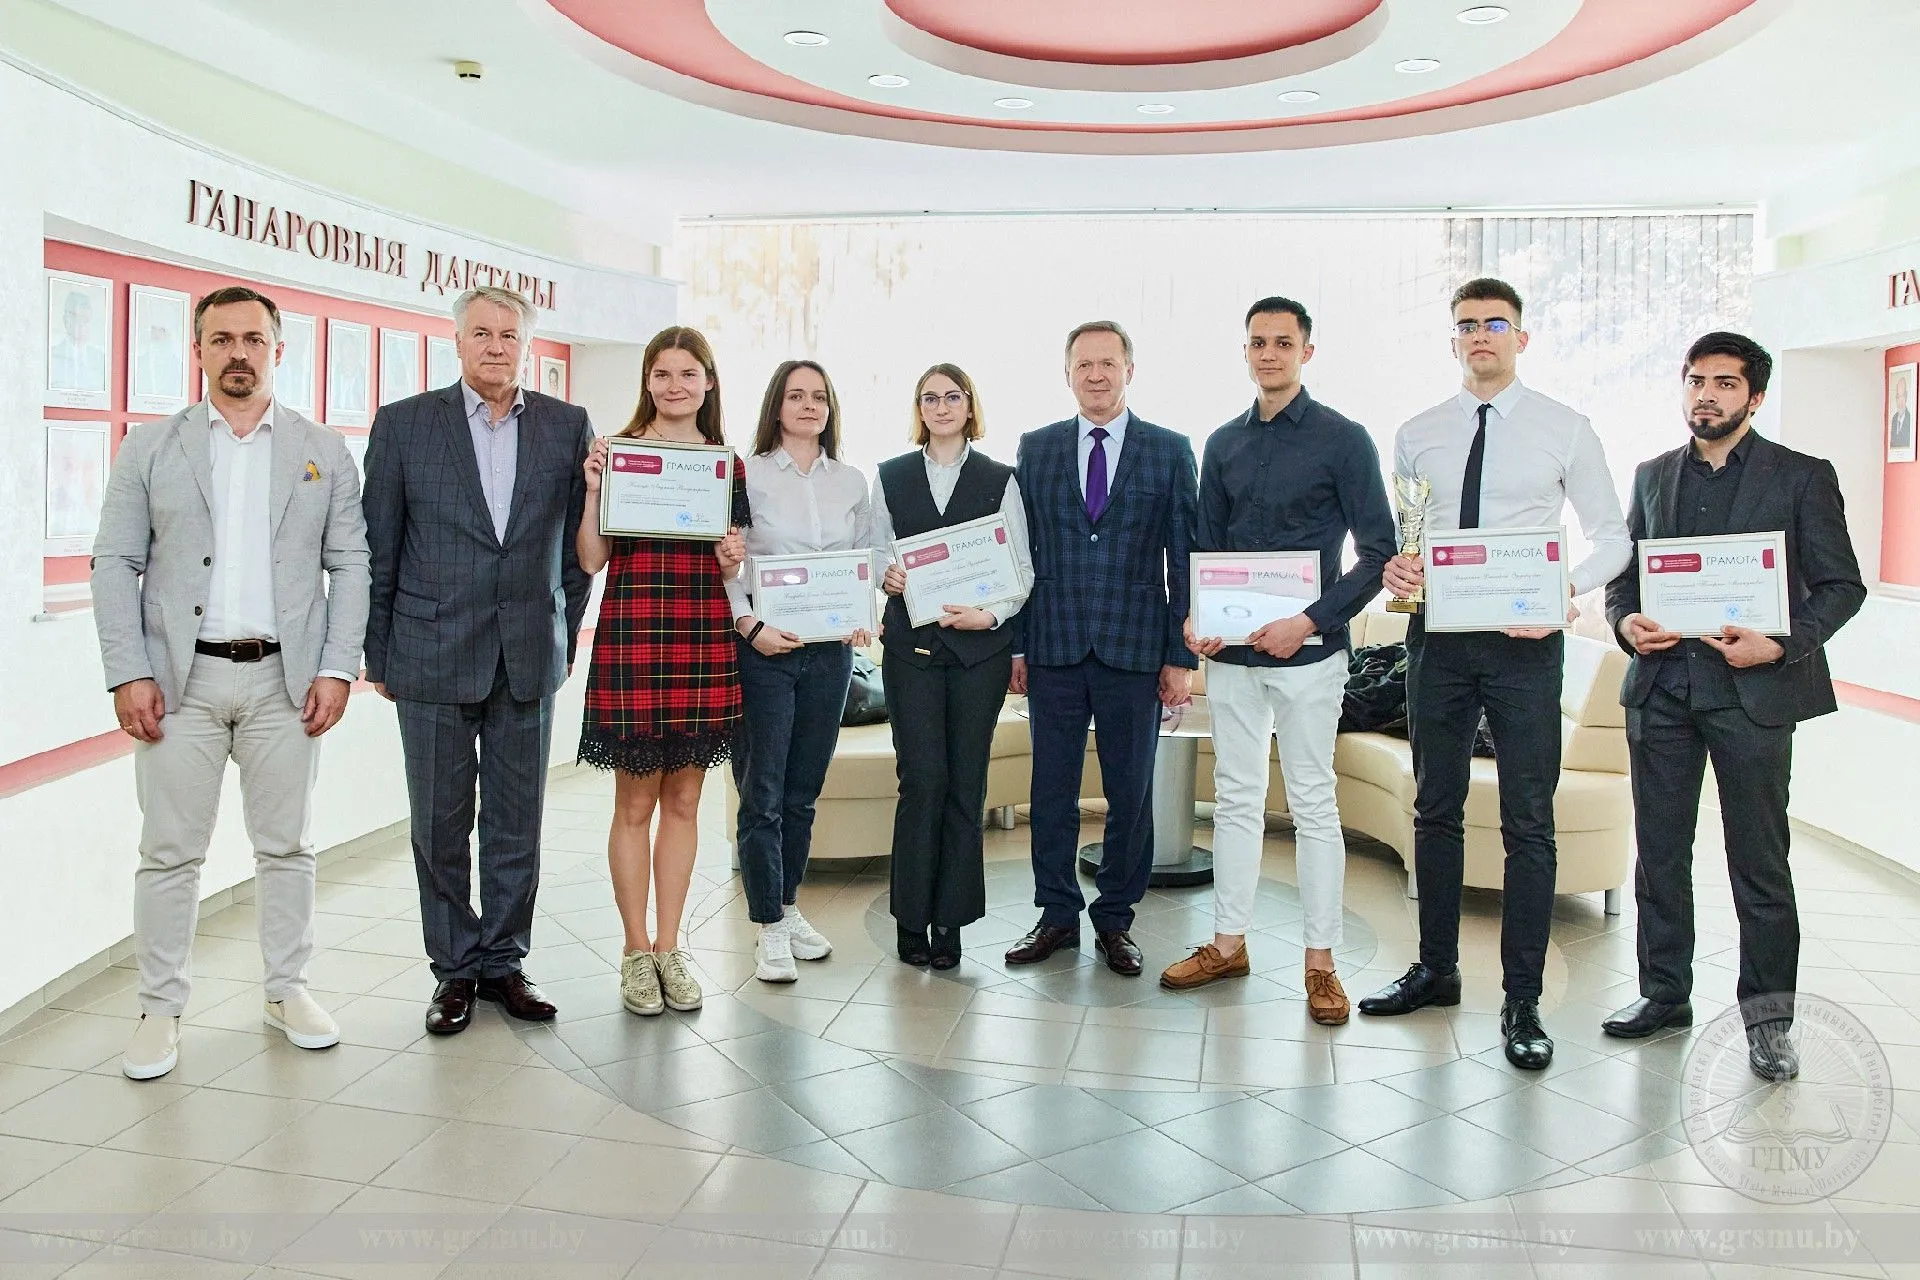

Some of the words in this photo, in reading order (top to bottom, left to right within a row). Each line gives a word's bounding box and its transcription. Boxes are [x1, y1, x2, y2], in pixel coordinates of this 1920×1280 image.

[185, 179, 408, 278] ГАНАРОВЫЯ
[421, 249, 557, 311] ДАКТАРЫ
[666, 461, 713, 473] ГРАМОТА
[951, 535, 993, 553] ГРАМОТА
[1490, 547, 1544, 559] ГРАМОТА
[1705, 554, 1759, 567] ГРАМОТА
